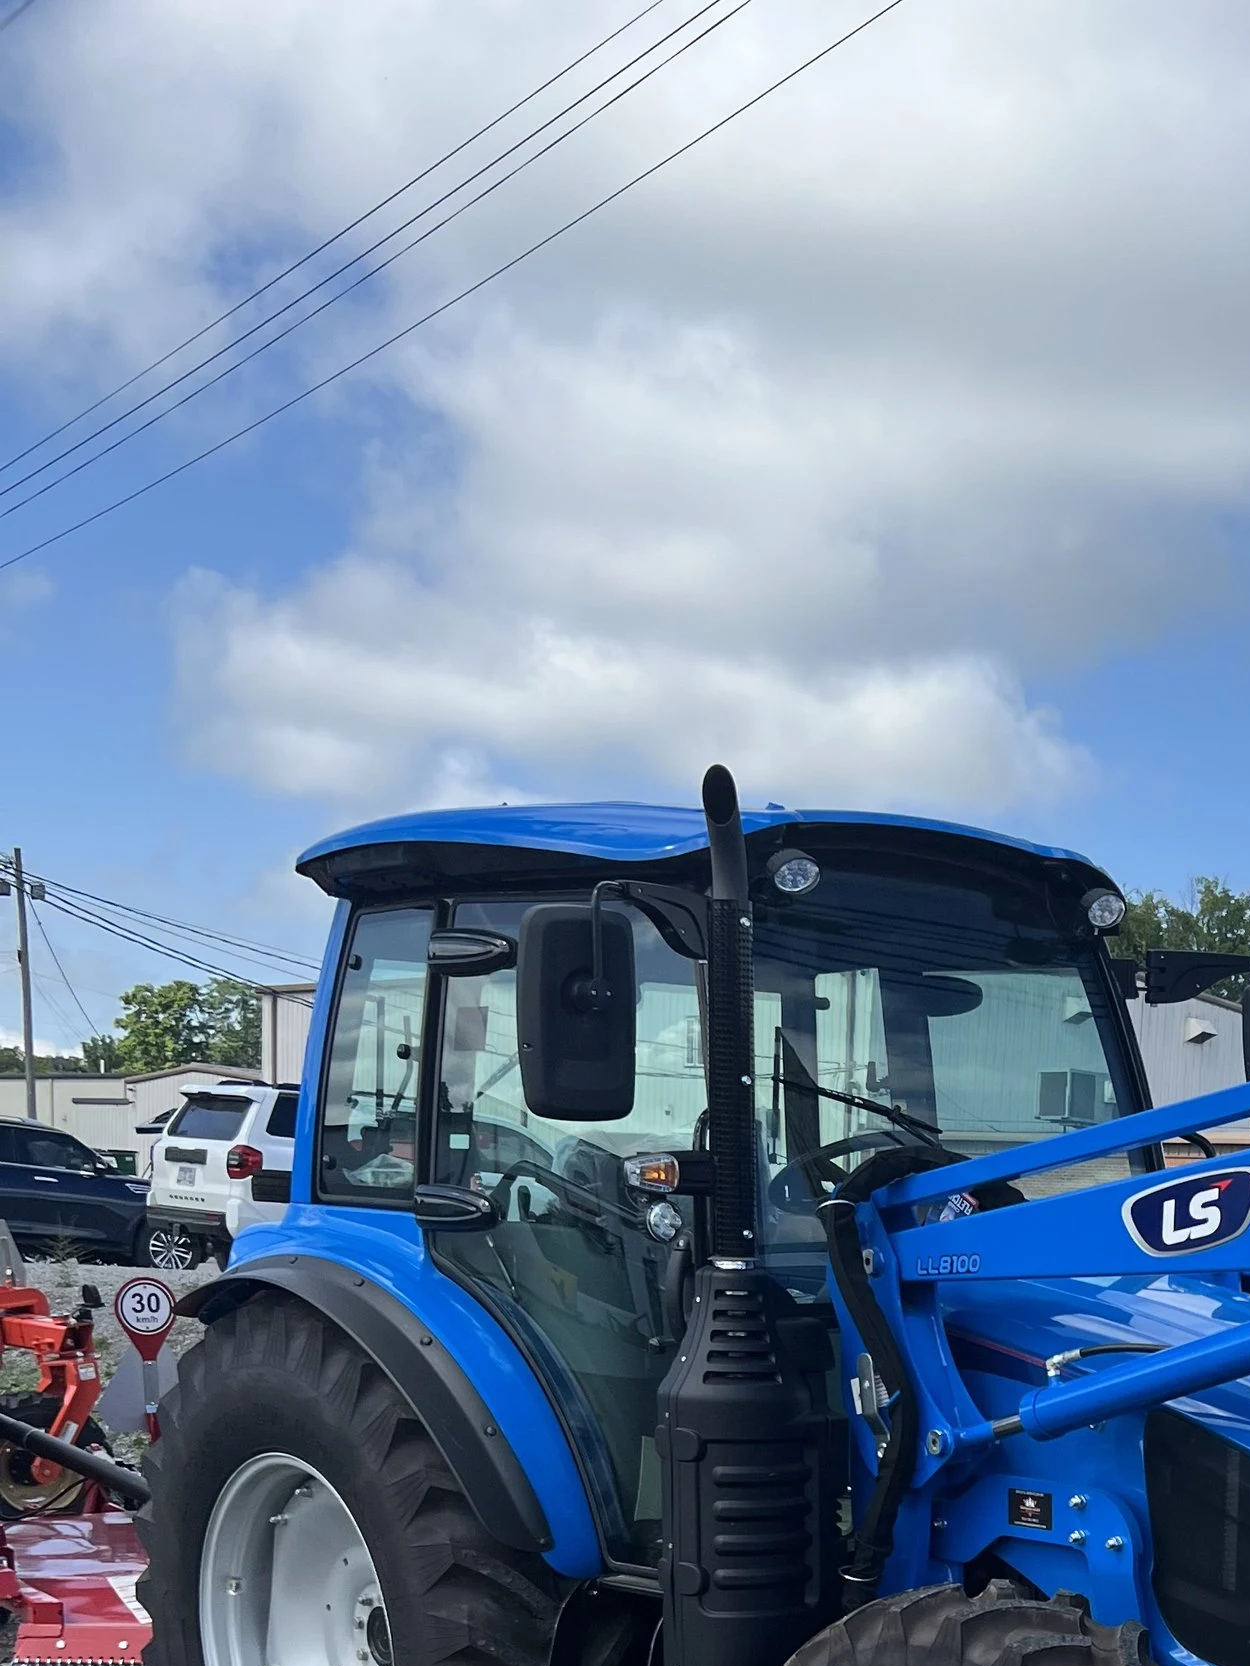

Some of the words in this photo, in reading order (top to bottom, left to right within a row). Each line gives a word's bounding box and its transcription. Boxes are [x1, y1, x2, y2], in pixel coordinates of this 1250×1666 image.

[1162, 1187, 1221, 1245] LS
[917, 1255, 980, 1275] LL8100
[131, 1292, 160, 1313] 30
[136, 1315, 159, 1324] km/h
